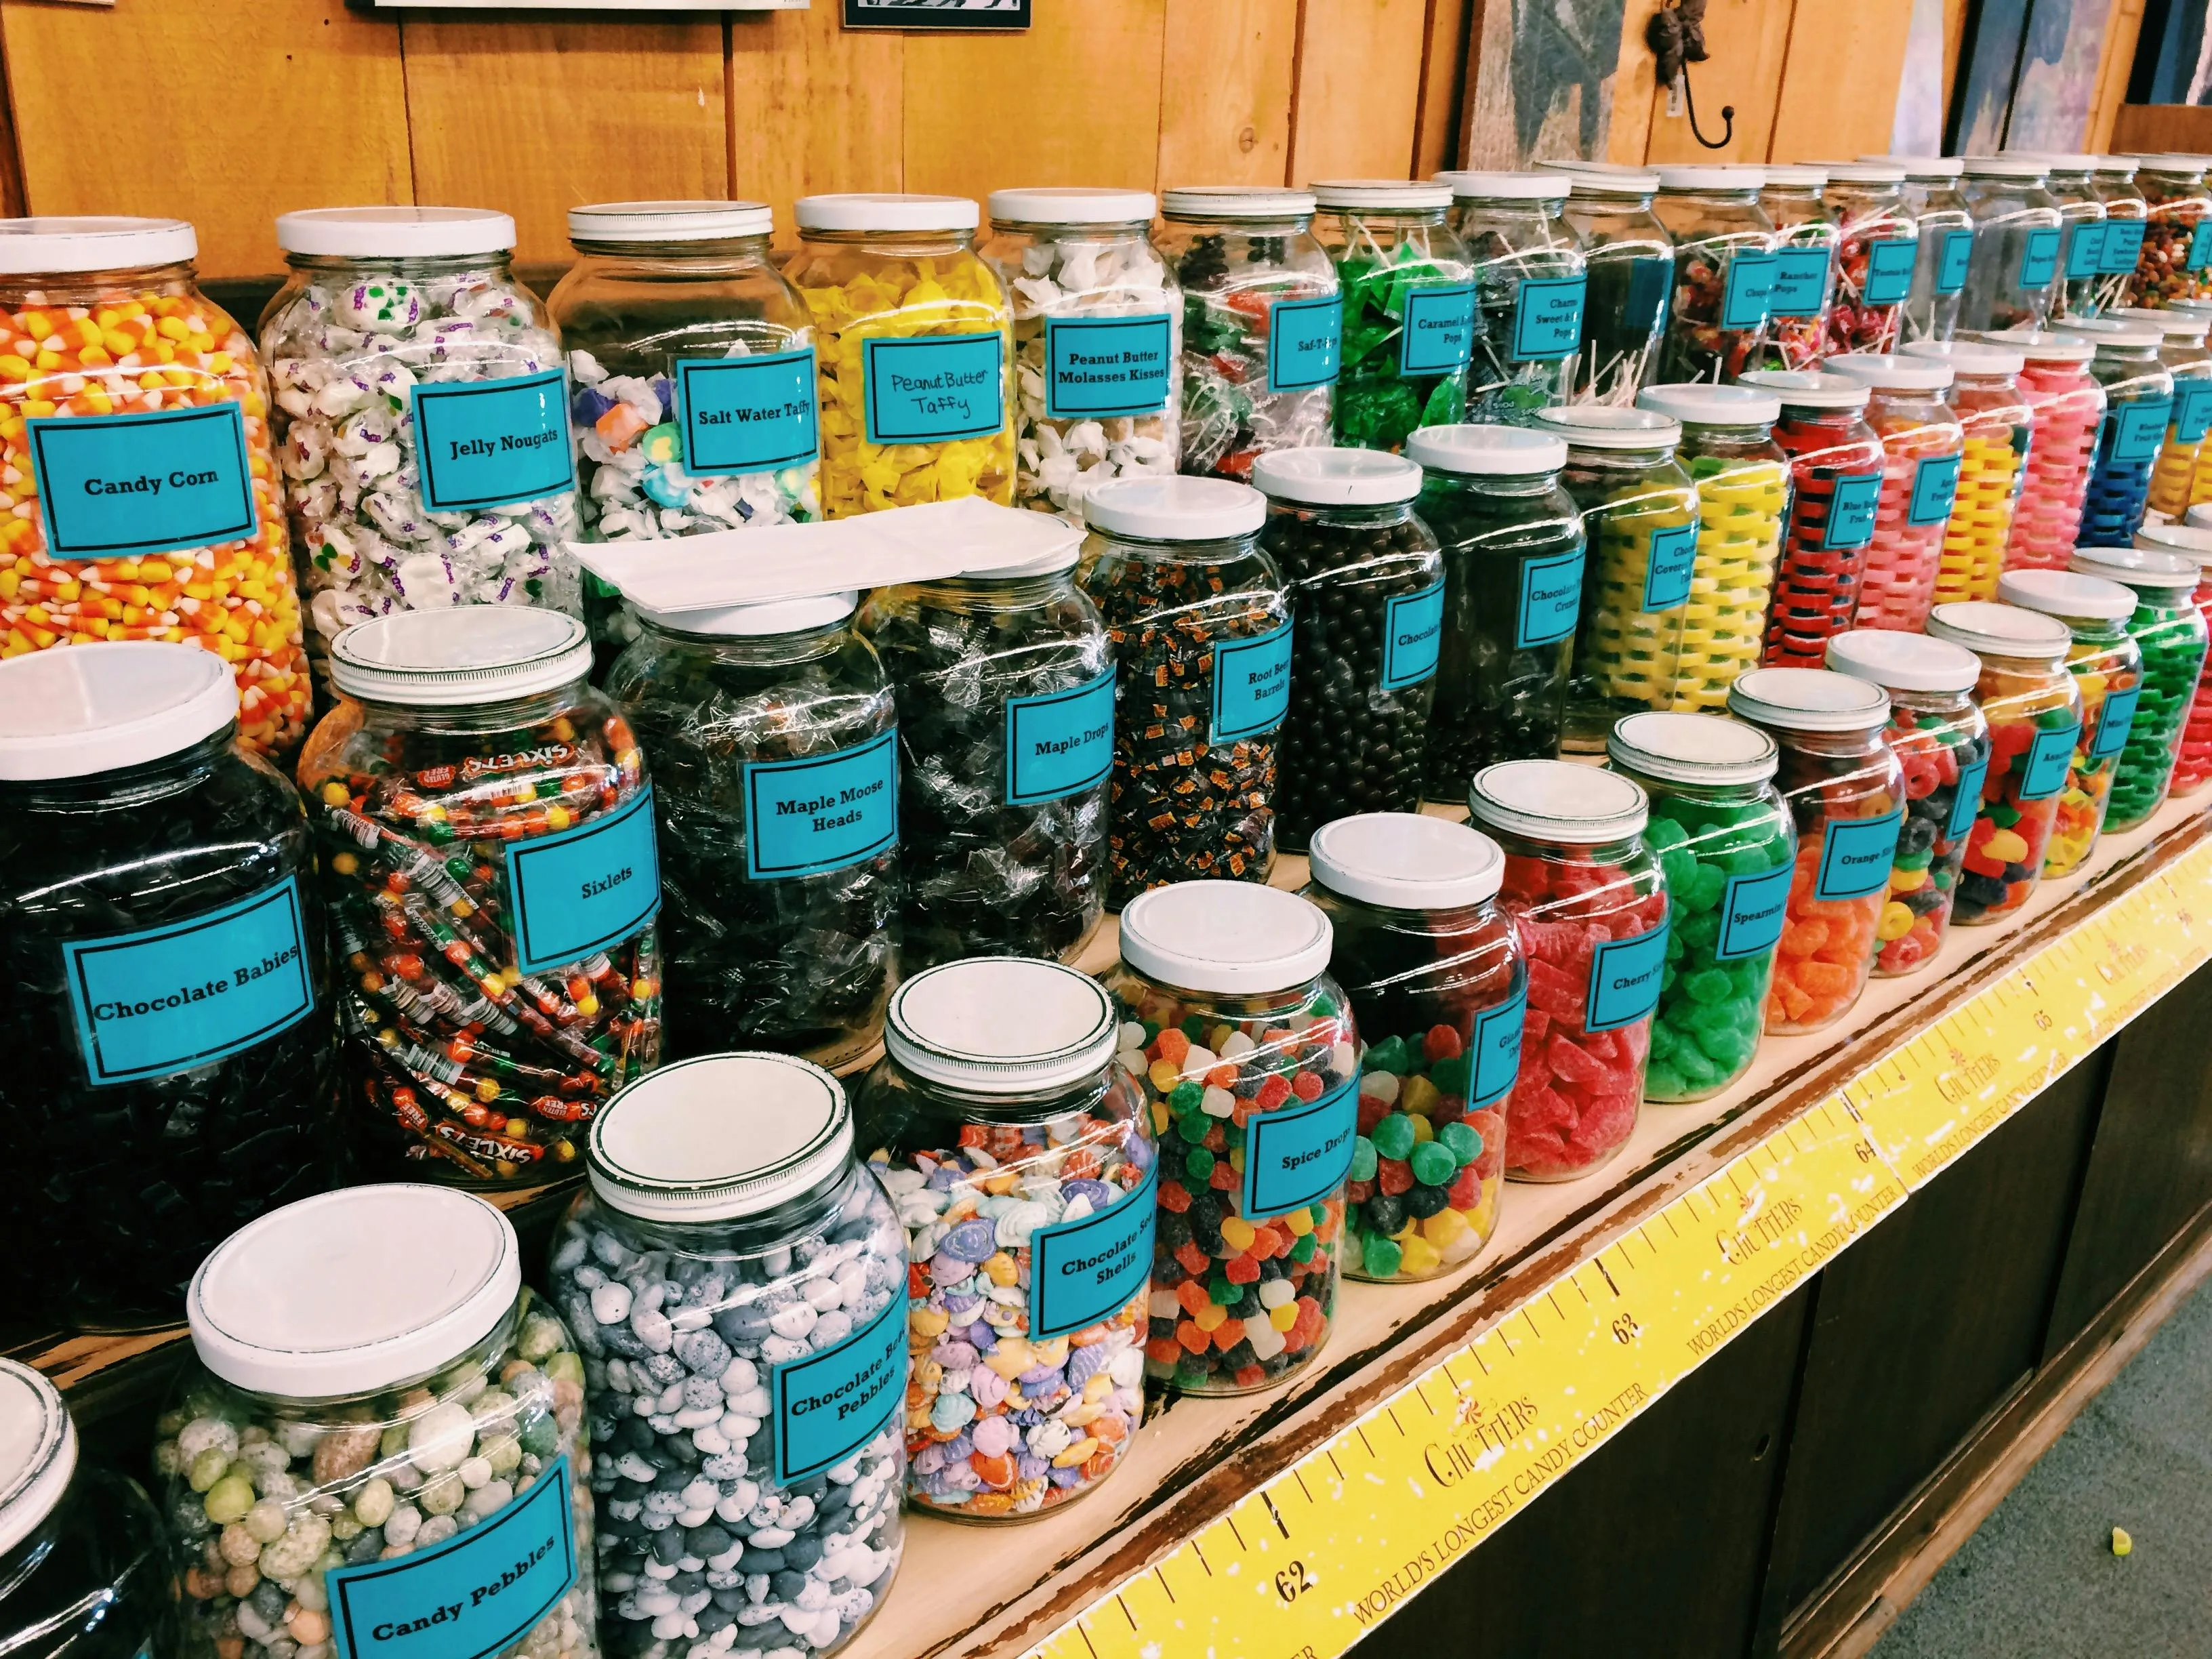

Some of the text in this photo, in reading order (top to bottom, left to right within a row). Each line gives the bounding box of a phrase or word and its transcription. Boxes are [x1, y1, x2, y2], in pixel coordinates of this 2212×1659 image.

[1418, 315, 1460, 329] Caramel
[1069, 351, 1159, 365] Peanut Butter
[891, 369, 989, 392] Peanut Butter
[1059, 369, 1164, 384] Molasses Kisses
[699, 399, 810, 425] Salt Water Taffy
[911, 396, 971, 419] Taffy
[450, 428, 558, 460] Jelly Nougats
[84, 471, 219, 495] Candy Corn
[1248, 659, 1289, 685] Root Beer
[1254, 678, 1285, 701] Barrels
[1036, 722, 1109, 756] Maple Drops
[776, 780, 884, 815] Maple Moose
[813, 810, 862, 832] Heads
[1841, 853, 1880, 865] Orange
[581, 867, 632, 899] Sixlets
[94, 943, 300, 1021] Chocolate Babies
[1614, 970, 1652, 989] Cherry
[2033, 1010, 2053, 1031] 65
[1953, 1105, 2000, 1149] LONGEST
[1282, 1149, 1321, 1170] Spice
[1854, 1138, 1877, 1164] 64
[1062, 1231, 1138, 1276] Chocolate
[1097, 1252, 1136, 1286] Shells
[1686, 1185, 1899, 1357] WORLD'S LONGEST CANDY COUNTER
[1612, 1312, 1639, 1345] 63
[791, 1357, 883, 1416] Chocolate
[838, 1365, 895, 1421] Pebbles
[1354, 1381, 1650, 1625] WORLD'S LONGEST CANDY COUNTER
[372, 1534, 554, 1641] Candy Pebbles
[1275, 1560, 1313, 1603] 62
